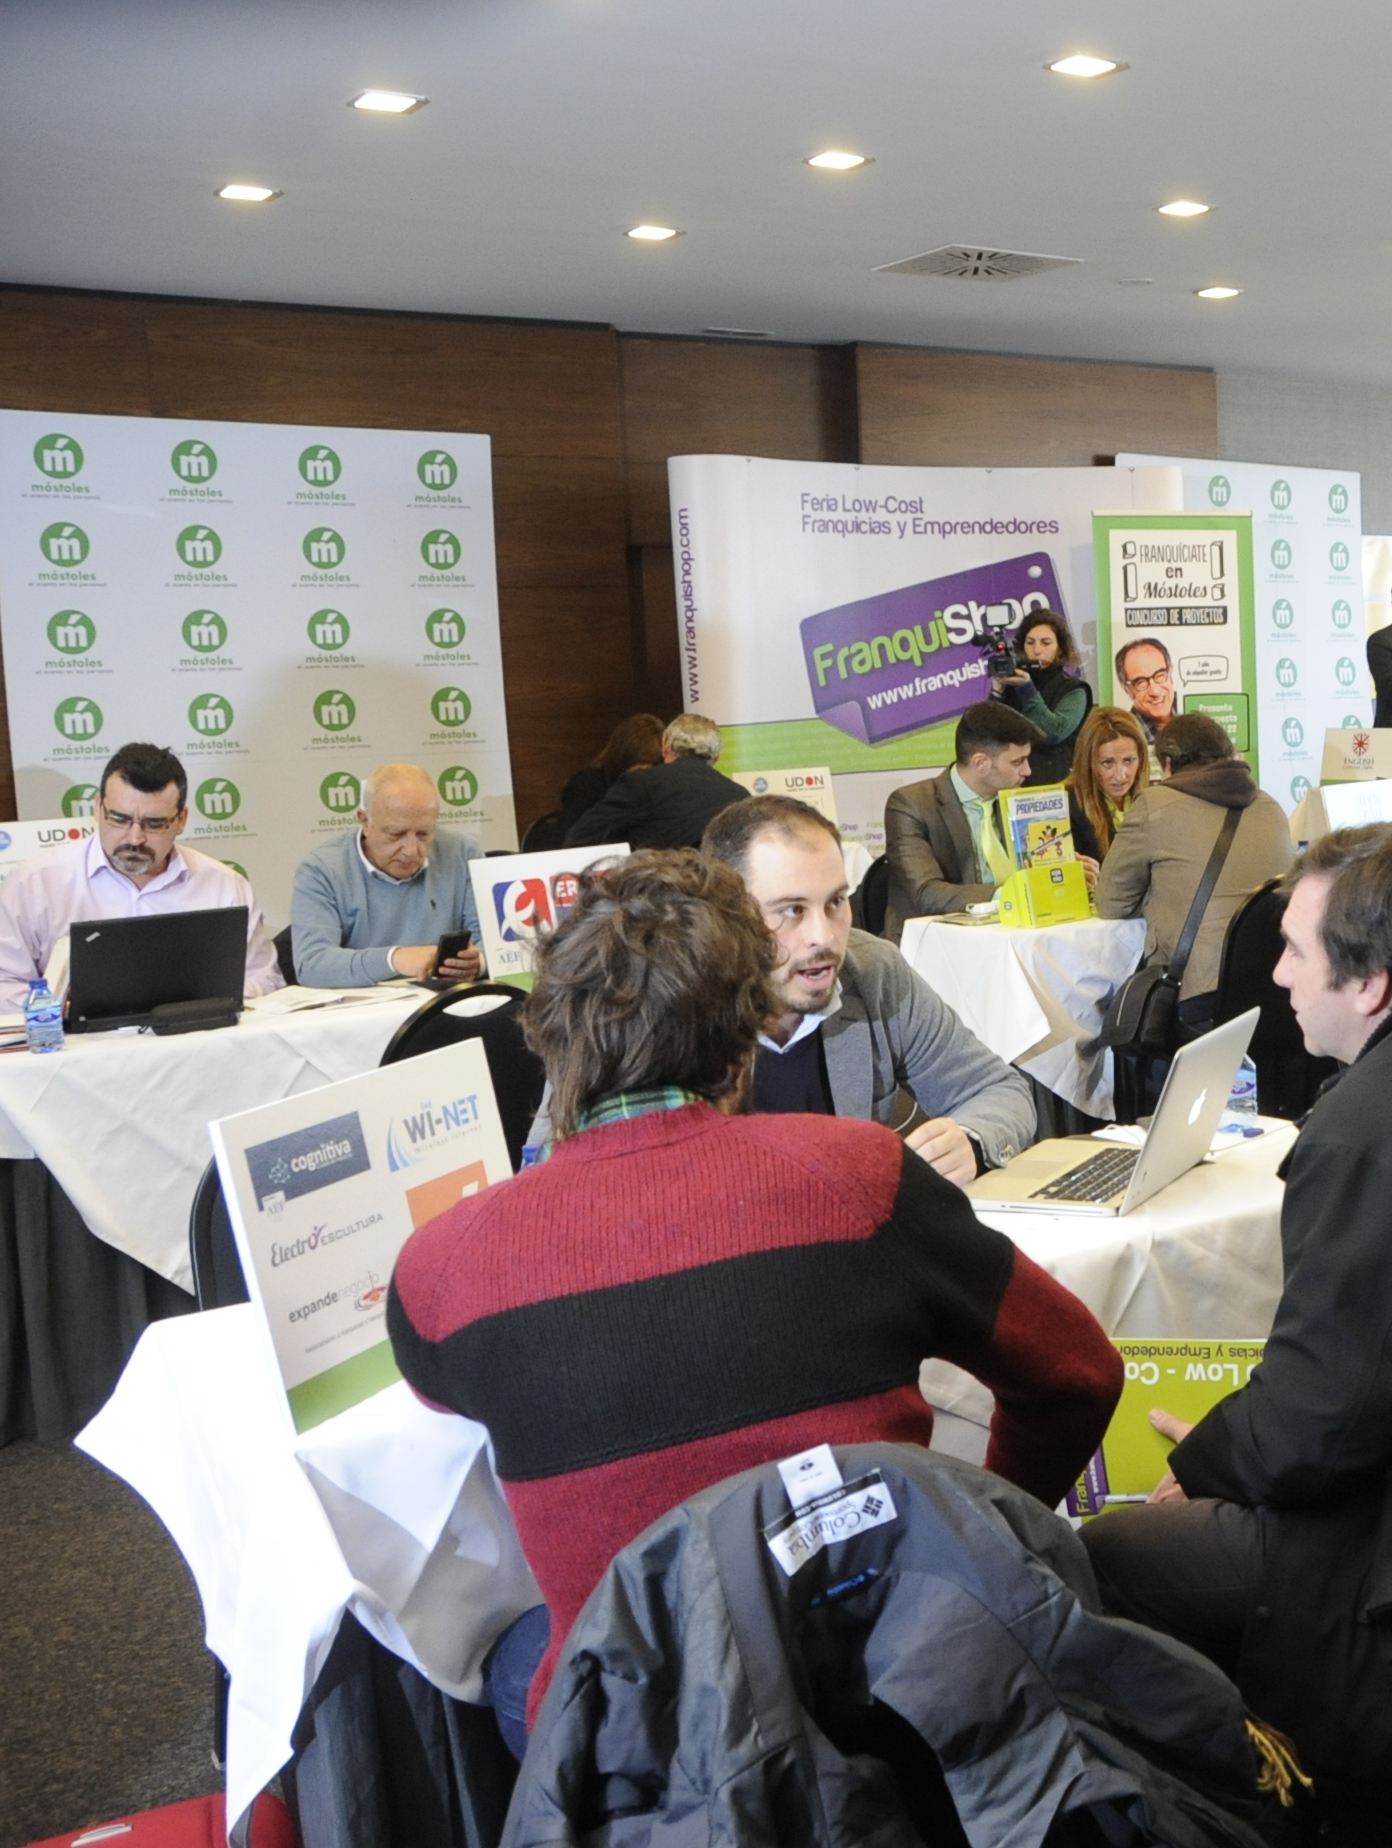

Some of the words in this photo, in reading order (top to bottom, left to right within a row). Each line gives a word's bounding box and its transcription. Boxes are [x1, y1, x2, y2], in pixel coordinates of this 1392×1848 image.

[31, 482, 90, 494] móstoles
[169, 487, 223, 497] móstoles
[296, 490, 346, 501] móstoles
[415, 494, 462, 504] móstoles
[801, 493, 838, 513] Feria
[841, 495, 924, 515] Low-Cost
[802, 516, 891, 538] Franquicias
[898, 519, 907, 539] y
[912, 518, 1059, 539] Emprendedores
[1140, 542, 1207, 563] FRANQUÍCIATE
[38, 570, 97, 581] móstoles
[174, 572, 228, 582] móstoles
[300, 572, 350, 582] móstoles
[419, 573, 466, 582] móstoles
[1165, 566, 1183, 578] en
[1143, 581, 1207, 599] Móstoles
[678, 508, 700, 704] www.franquishop.com
[1127, 609, 1168, 625] CONCURSO
[1170, 609, 1180, 624] DE
[1182, 608, 1223, 624] PROYECTOS
[180, 656, 234, 666] móstoles
[305, 653, 355, 663] móstoles
[423, 652, 471, 662] móstoles
[45, 658, 103, 669] móstoles
[867, 659, 988, 710] www.franquish
[312, 734, 362, 745] móstoles
[430, 730, 477, 740] móstoles
[52, 743, 110, 755] móstoles
[186, 739, 240, 750] móstoles
[1016, 798, 1063, 815] PROPIEDADES
[194, 822, 247, 833] móstoles
[318, 816, 361, 827] móstol
[290, 1139, 352, 1172] cognitiva
[1120, 1344, 1210, 1359] Emprendedor
[1216, 1344, 1224, 1357] y
[1125, 1362, 1160, 1385] Co
[1184, 1362, 1239, 1386] Low
[788, 1511, 861, 1556] Columba
